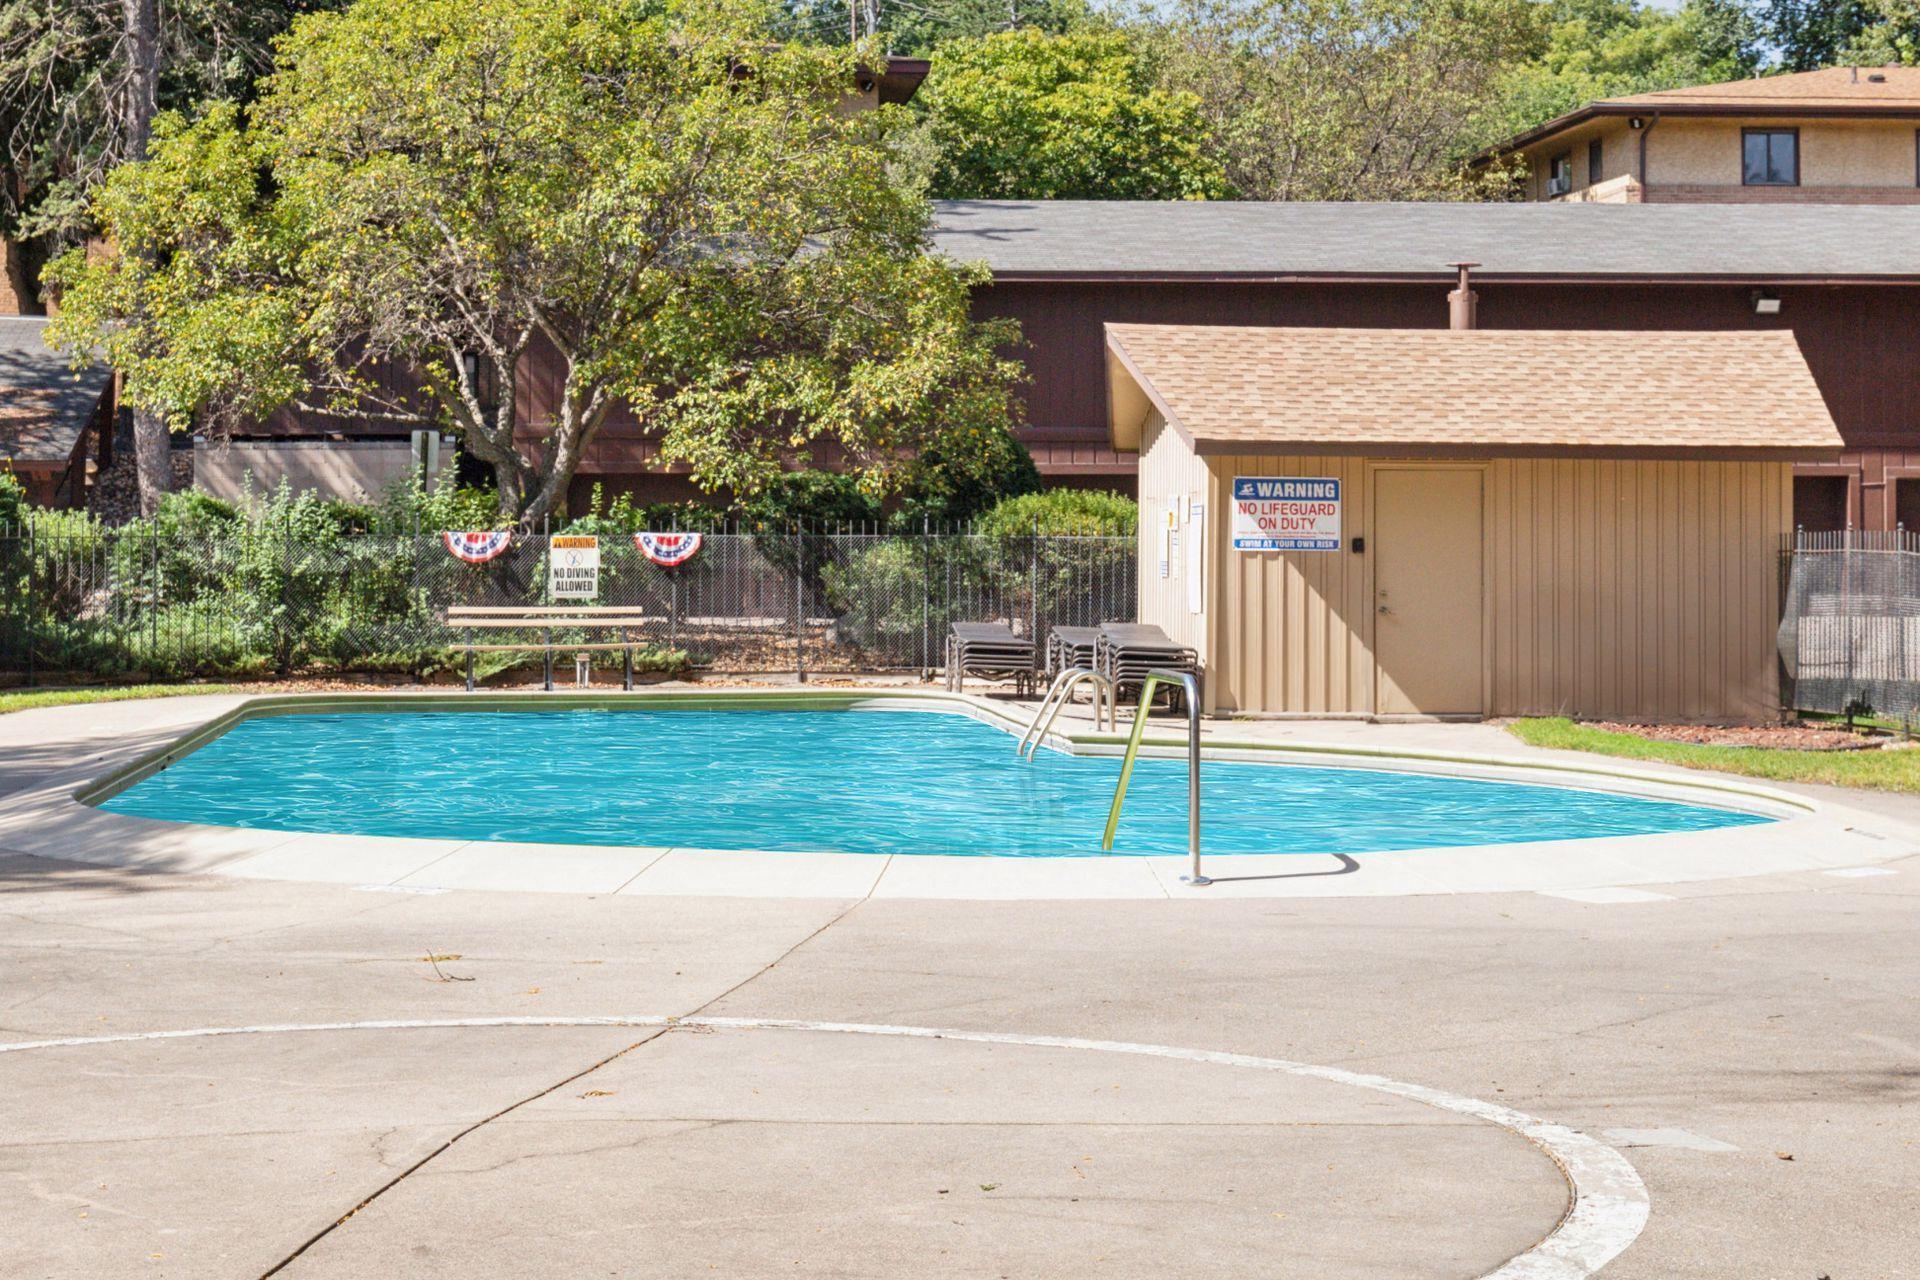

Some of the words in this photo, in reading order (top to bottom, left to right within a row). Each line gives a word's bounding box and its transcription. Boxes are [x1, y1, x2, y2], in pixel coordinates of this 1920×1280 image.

[1257, 482, 1336, 498] WARNING
[1238, 502, 1258, 515] NO
[1261, 503, 1336, 516] LIFEGUARD
[1258, 517, 1277, 530] ON
[1281, 518, 1316, 530] DUTY
[562, 537, 596, 548] WARNING
[1239, 540, 1262, 548] SWIM
[1263, 540, 1273, 548] AT
[1274, 540, 1295, 548] YOUR
[1296, 540, 1315, 548] OWN
[1316, 540, 1334, 548] RISK
[553, 567, 565, 578] NO
[567, 567, 595, 578] DIVING
[555, 580, 593, 591] ALLOWED
